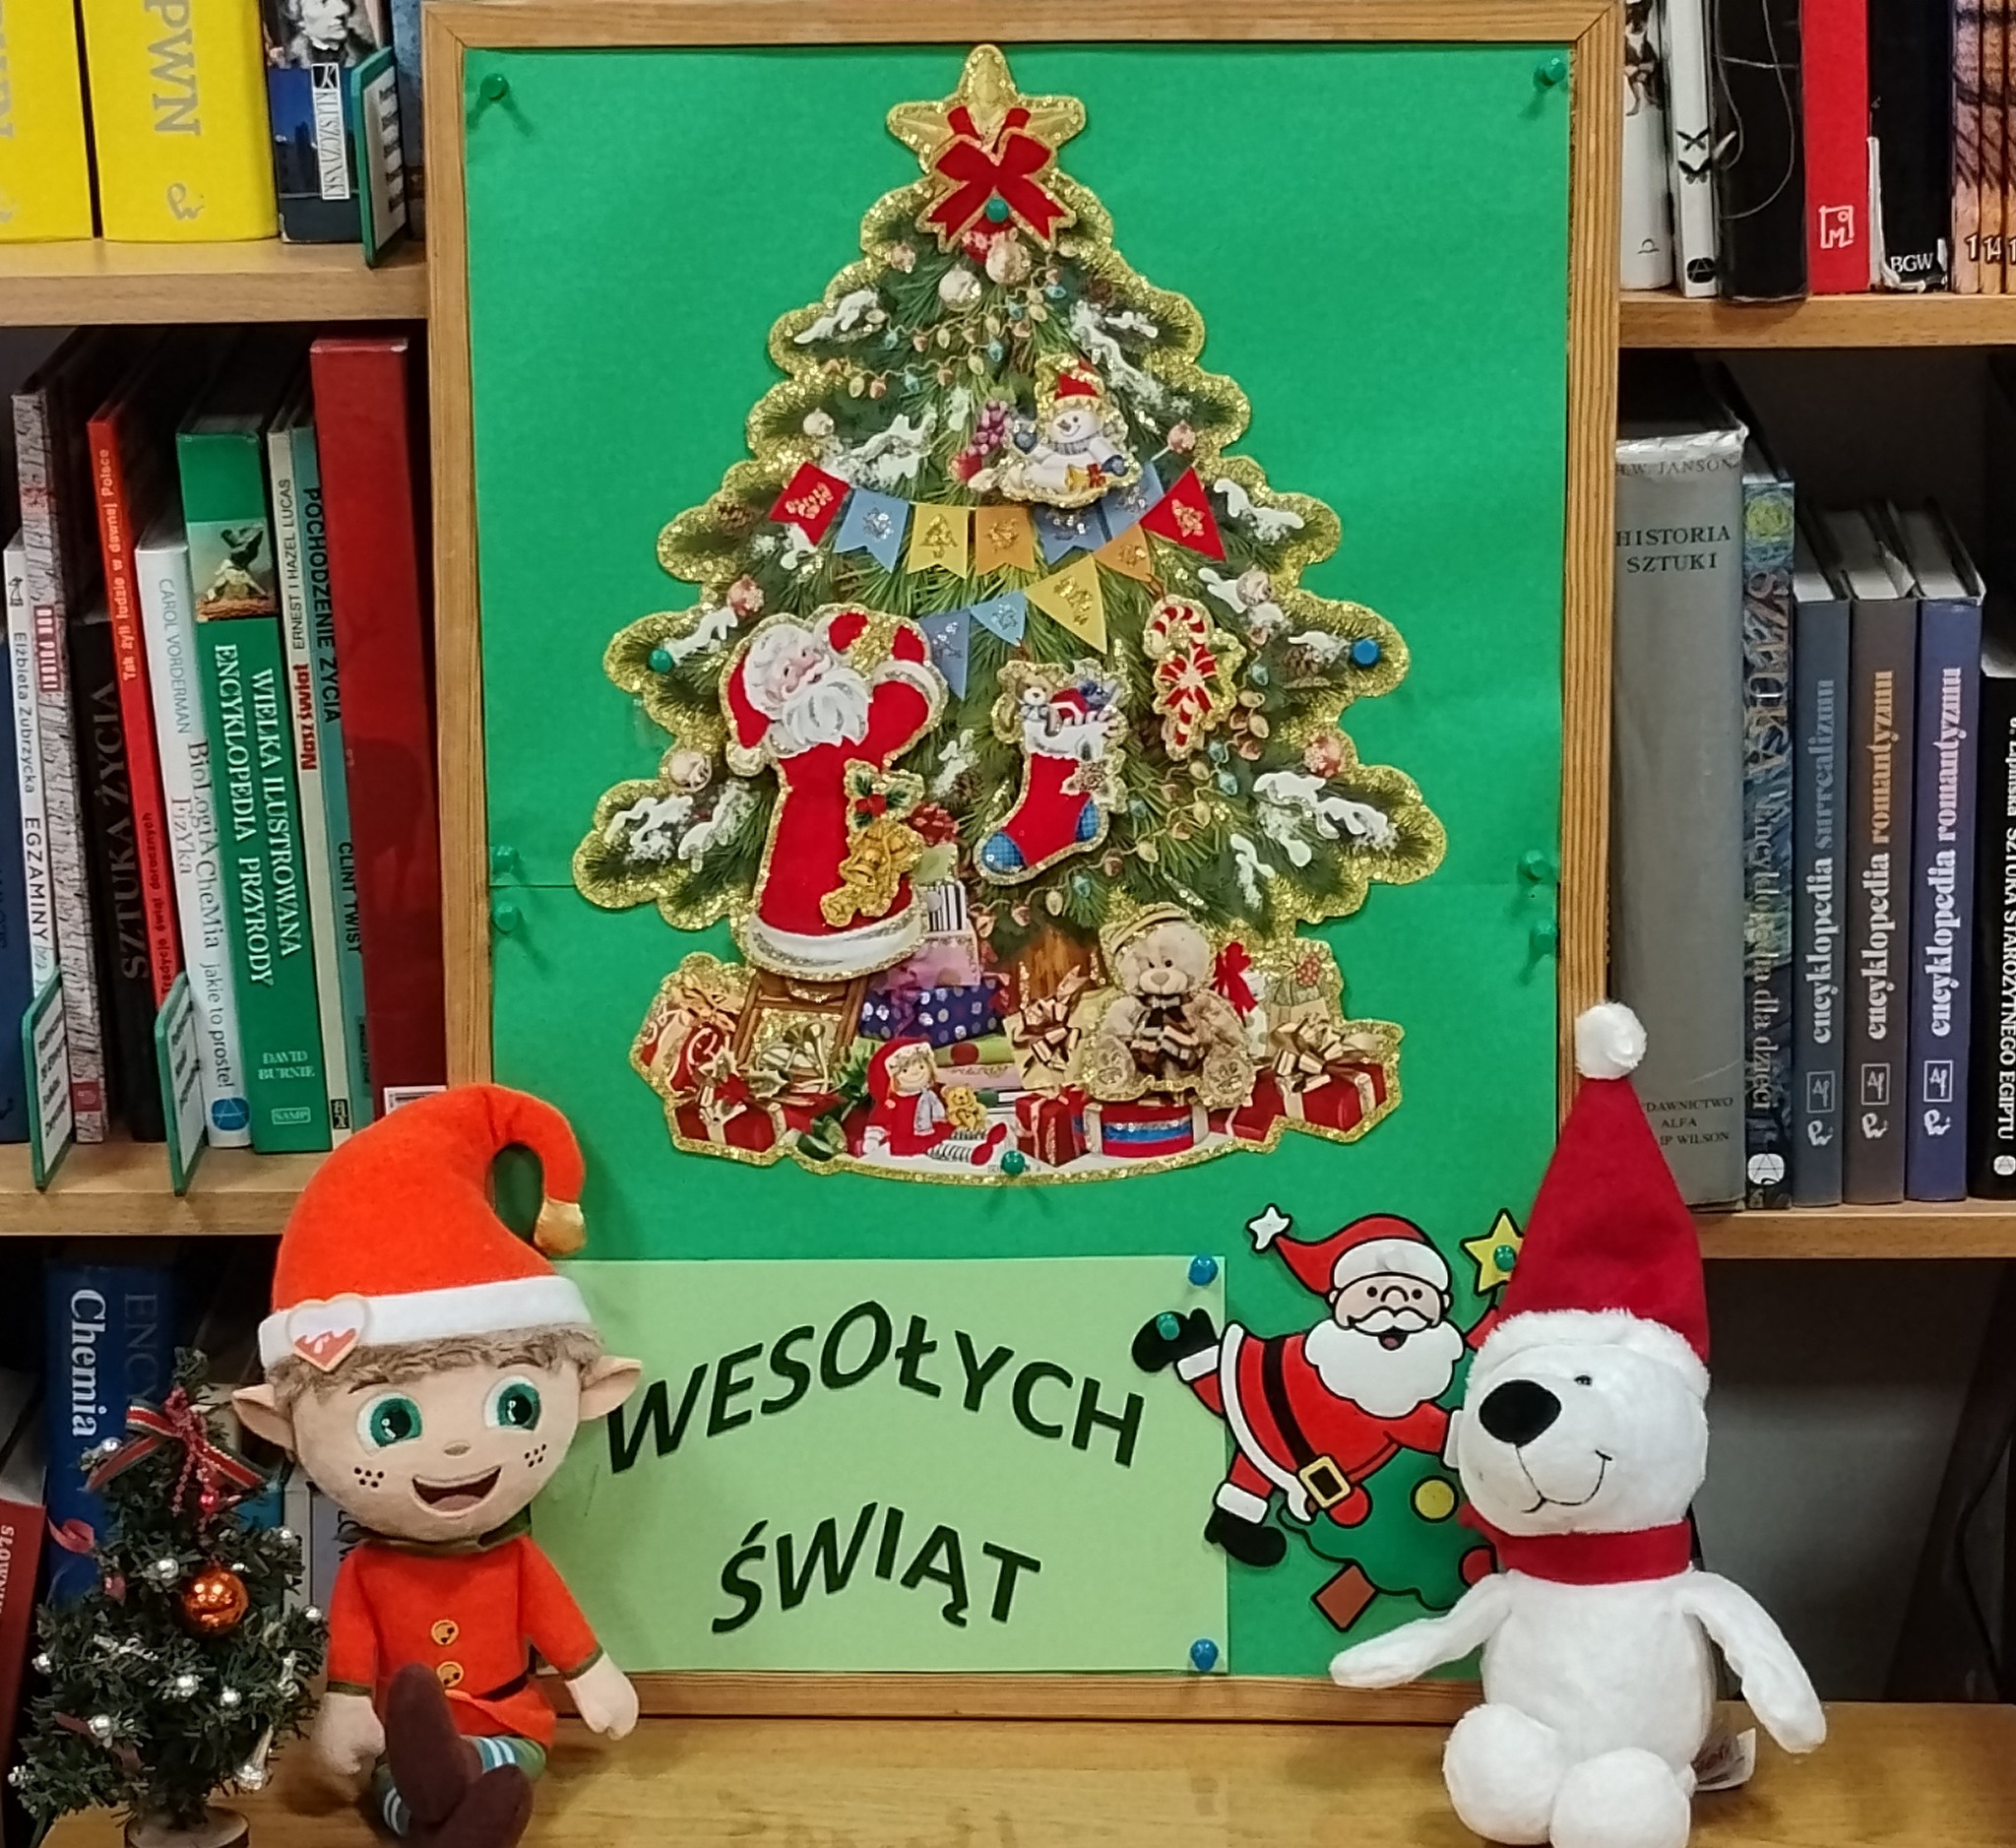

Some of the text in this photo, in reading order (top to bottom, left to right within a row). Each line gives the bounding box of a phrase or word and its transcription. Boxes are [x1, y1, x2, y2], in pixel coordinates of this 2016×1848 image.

[145, 0, 201, 136] PWN
[1890, 252, 1933, 273] BGW
[103, 502, 122, 552] dawnej
[277, 478, 295, 528] LUCAS
[1615, 525, 1731, 546] HISTORIA
[111, 558, 123, 571] w
[283, 531, 300, 581] HAZEL
[303, 487, 336, 649] POCHODZENIE
[1626, 552, 1717, 573] SZTUKI
[112, 577, 129, 619] ludzie
[287, 594, 306, 651] ERNEST
[13, 632, 30, 701] Elżbieta
[122, 656, 137, 681] Tak
[158, 578, 192, 734] CAROL VORDERMAN
[19, 707, 37, 794] Zubrzycka
[298, 729, 318, 772] Nasz
[1866, 669, 1900, 846] romantyzmu
[1932, 667, 1967, 842] romantyzmu
[214, 643, 275, 987] ENCYKLOPEDIA PRZYRODY
[251, 668, 302, 957] WIELKA ILUSTROWANA
[25, 817, 48, 941] EGZAMINY
[105, 815, 151, 980] SZTUKA
[338, 842, 362, 953] CLINT TWIST
[1806, 858, 1840, 1045] encyklopedia
[1860, 852, 1896, 1041] encyklopedia
[1925, 849, 1961, 1038] encyklopedia
[200, 962, 225, 1001] jakie
[209, 1005, 224, 1024] to
[1752, 988, 1780, 1031] dla
[210, 1030, 234, 1088] proste!
[258, 1066, 316, 1080] BURNIE
[263, 1051, 308, 1065] DAVID
[1752, 1036, 1780, 1111] dzieci
[1661, 1117, 1697, 1128] ALFA
[1676, 1131, 1731, 1145] WILSON
[1998, 1070, 2016, 1141] EGIPTU
[70, 1289, 107, 1437] Chemia
[604, 1300, 1145, 1475] WESOŁYCH
[711, 1501, 1041, 1633] ŚWIĄT
